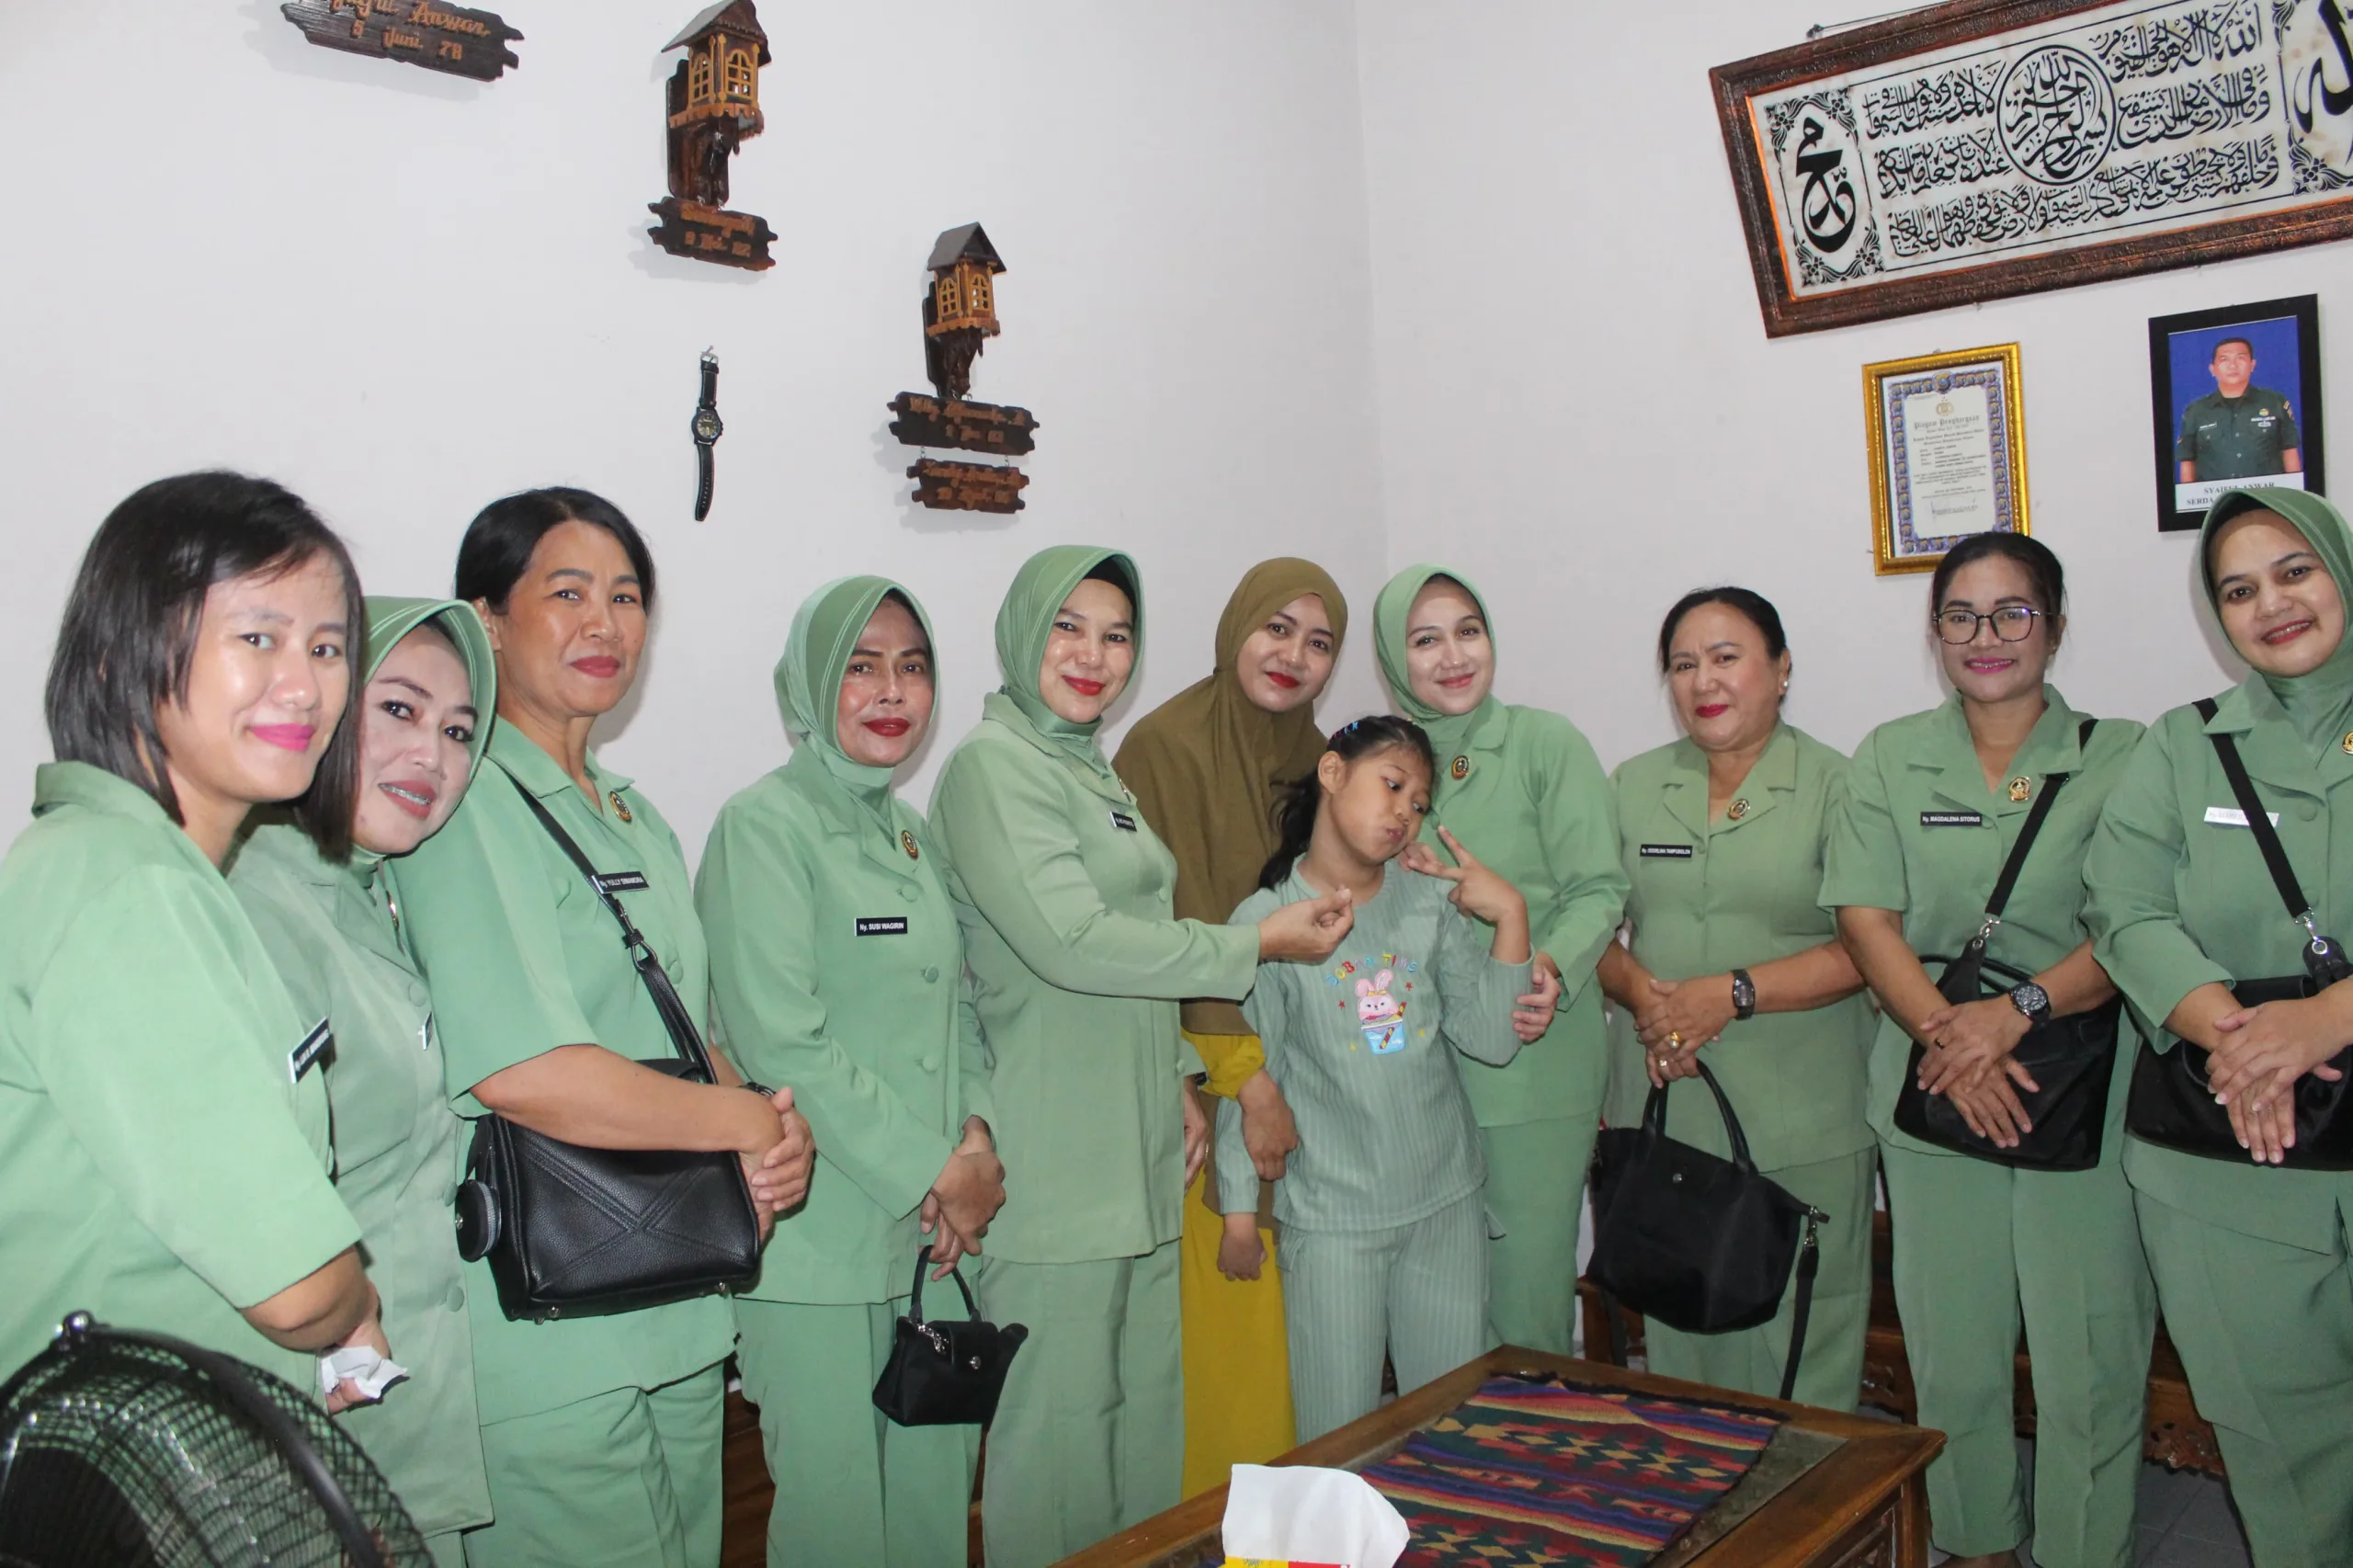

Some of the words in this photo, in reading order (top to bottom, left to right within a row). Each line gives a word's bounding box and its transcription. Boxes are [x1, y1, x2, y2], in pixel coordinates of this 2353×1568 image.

[859, 923, 869, 932] Ny.
[868, 923, 881, 931] SUSI
[881, 922, 904, 930] WAGIRIN
